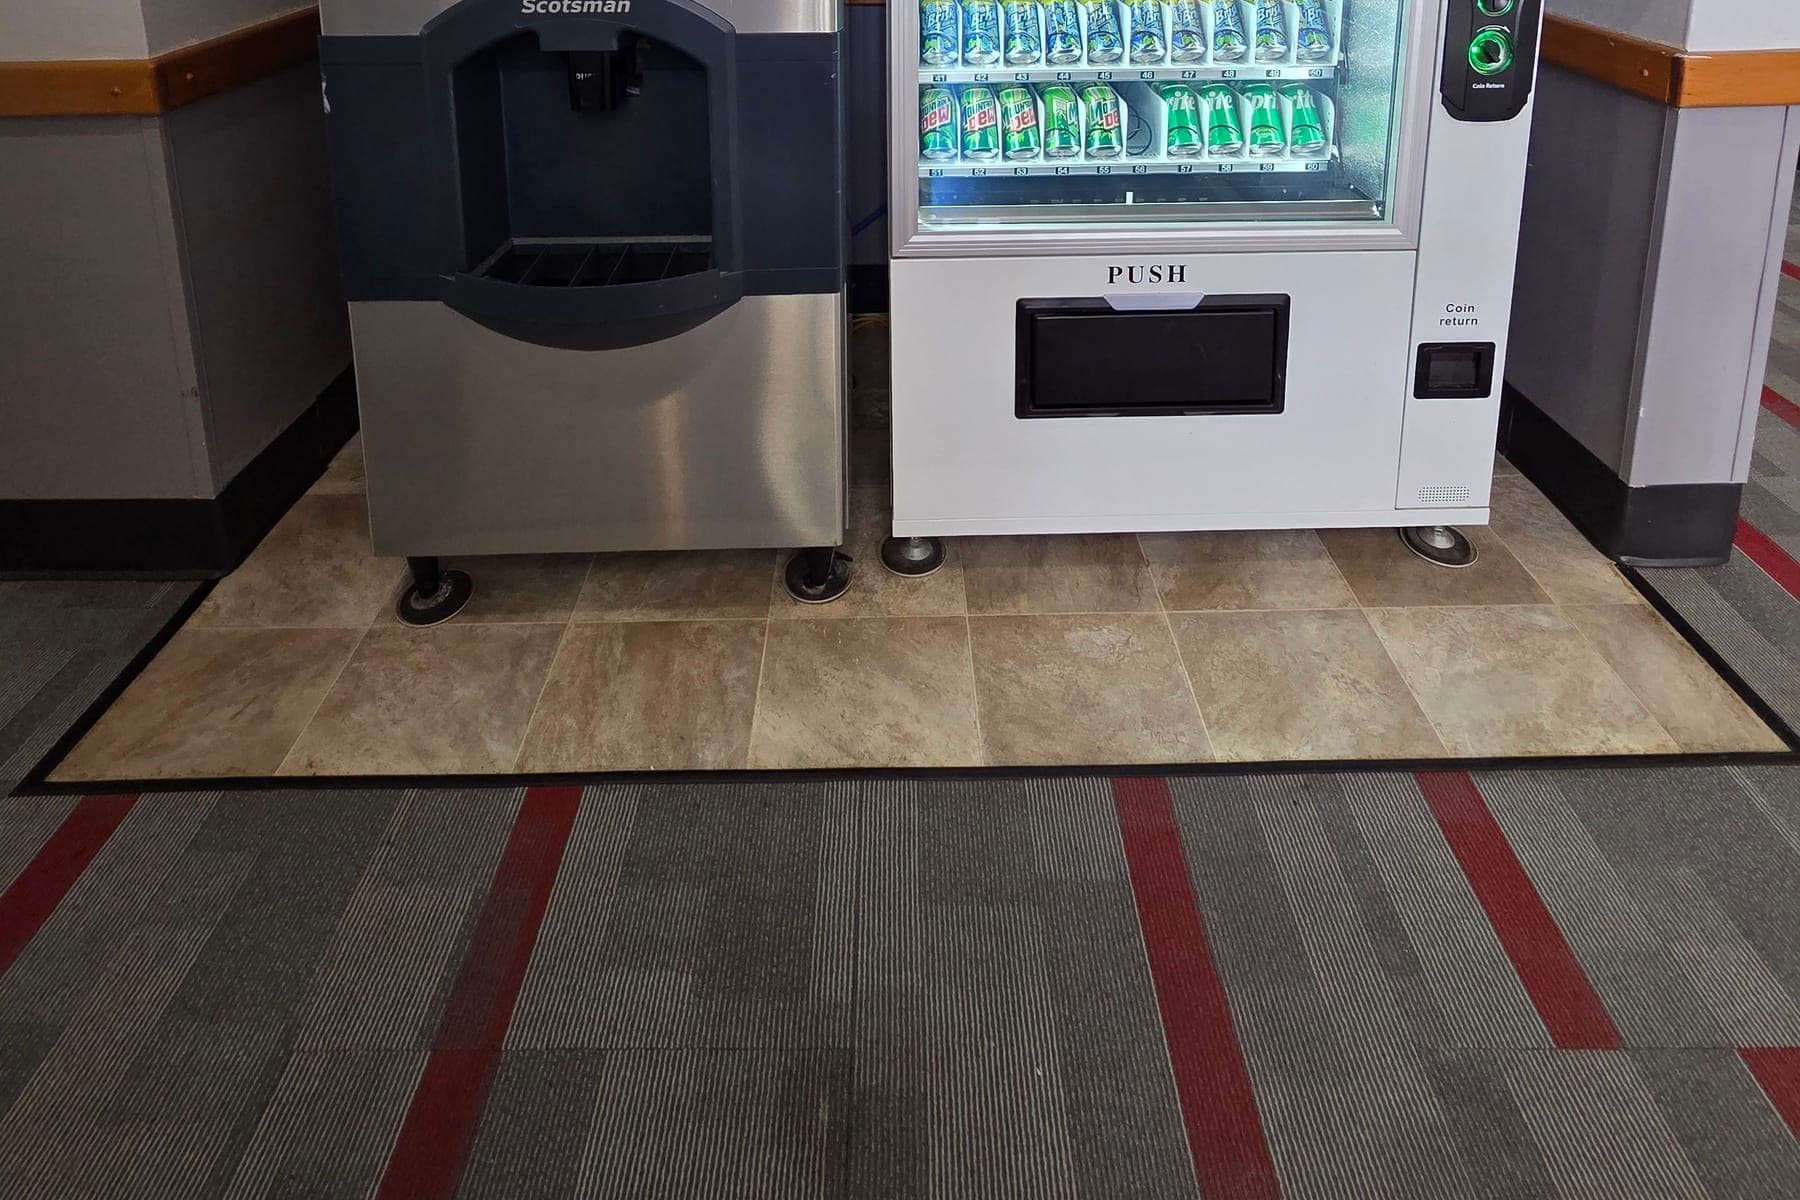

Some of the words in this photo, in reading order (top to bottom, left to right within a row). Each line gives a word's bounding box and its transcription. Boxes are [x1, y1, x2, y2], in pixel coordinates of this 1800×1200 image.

[1107, 264, 1187, 284] PUSH
[1446, 303, 1475, 313] Coin
[1440, 317, 1478, 326] return
